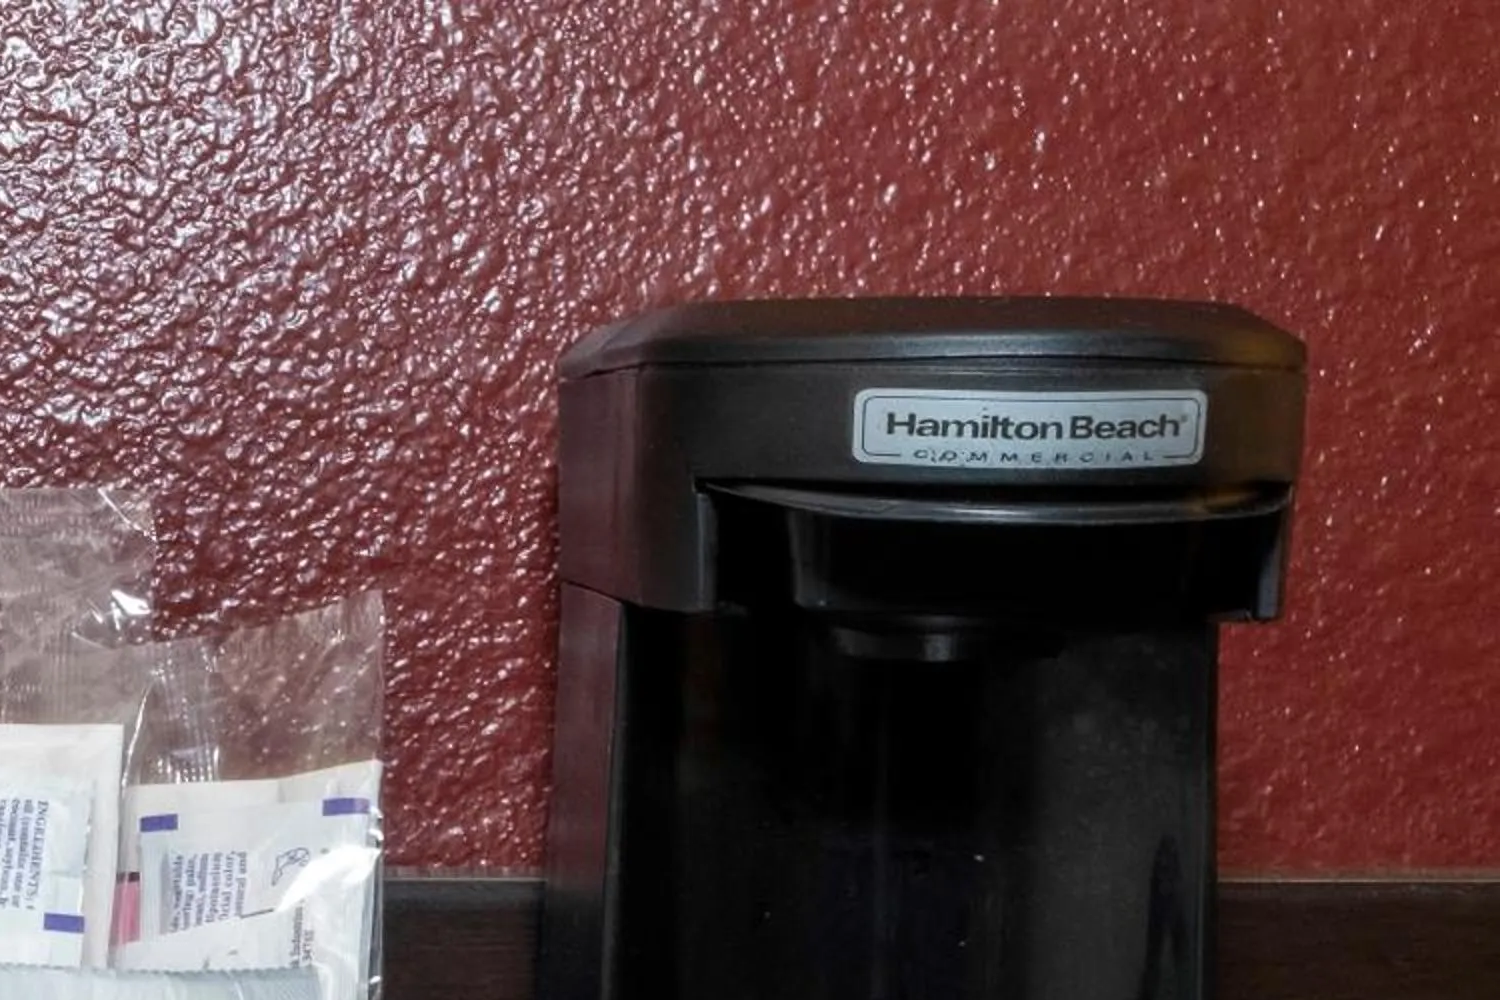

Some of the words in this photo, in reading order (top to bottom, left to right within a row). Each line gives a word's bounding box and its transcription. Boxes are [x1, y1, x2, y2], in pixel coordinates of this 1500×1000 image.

[886, 411, 1062, 440] Hamilton
[1069, 414, 1180, 440] Beach
[913, 449, 1155, 463] COMMERCIAL
